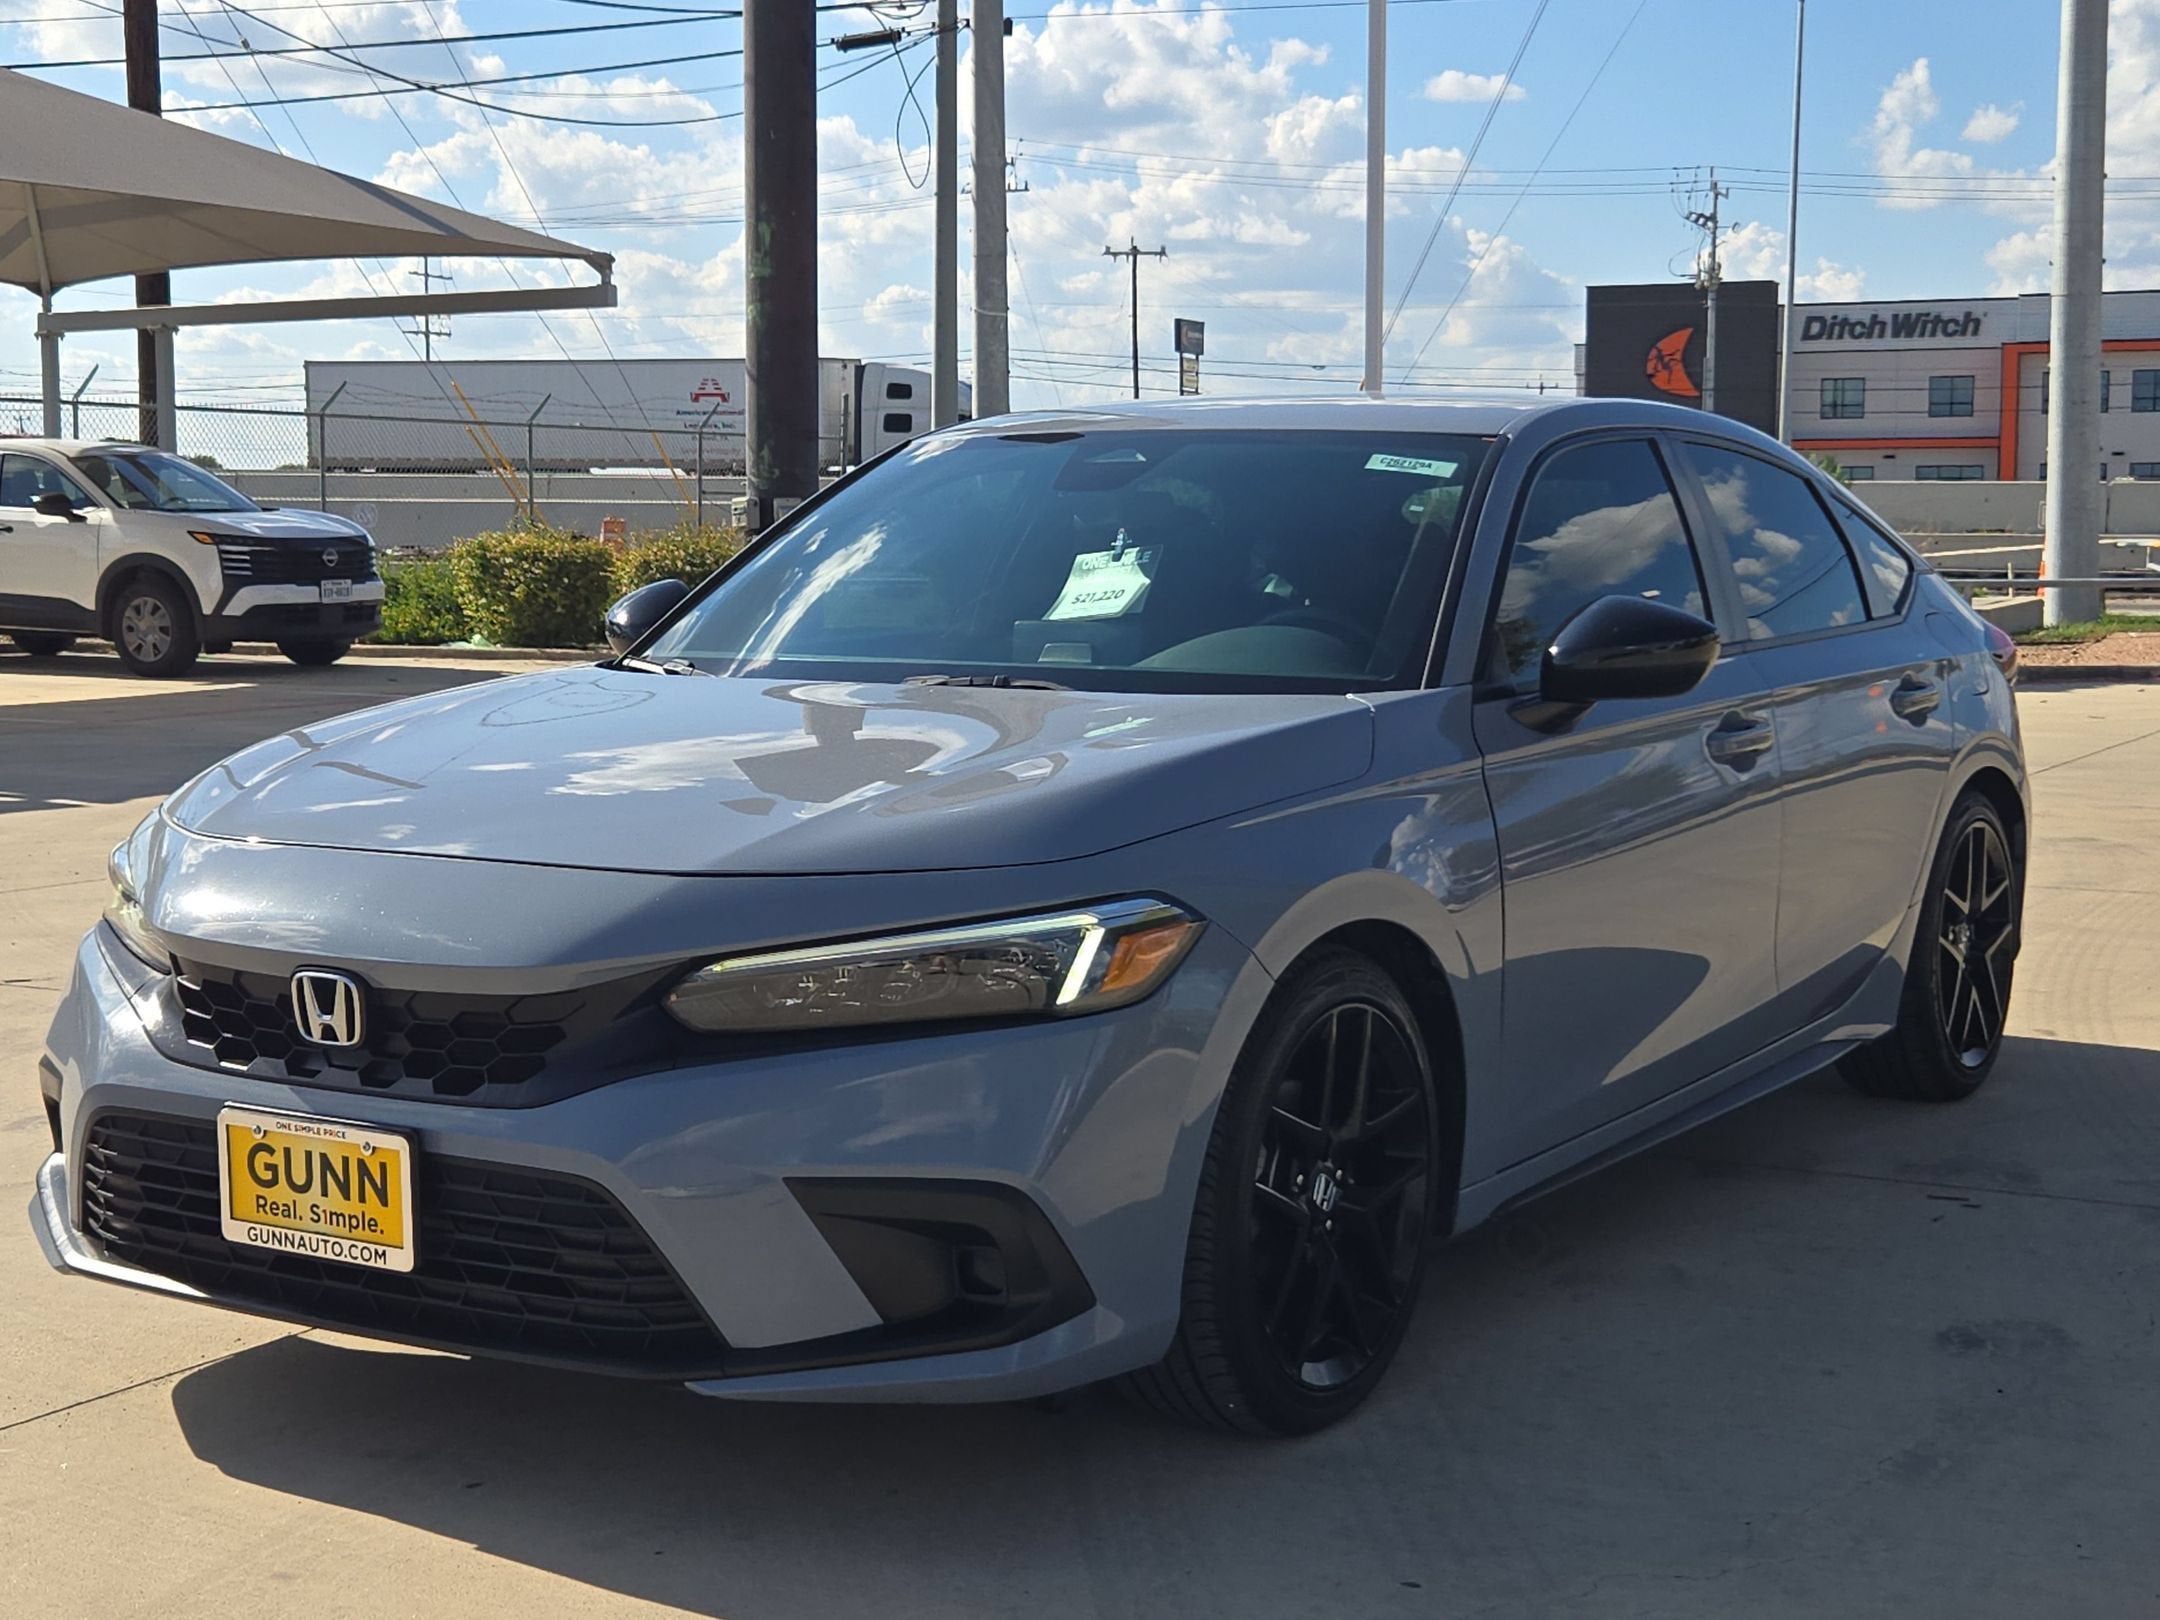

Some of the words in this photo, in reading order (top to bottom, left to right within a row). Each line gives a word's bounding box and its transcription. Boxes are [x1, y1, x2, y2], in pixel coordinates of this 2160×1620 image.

[1800, 313, 1887, 341] Ditch
[1890, 311, 1981, 339] Witch
[1082, 555, 1109, 570] ONE
[1071, 589, 1125, 605] $21,220
[276, 1121, 292, 1131] ONE
[247, 1142, 389, 1208] GUNN
[256, 1194, 303, 1221] Real.
[247, 1226, 387, 1265] GUNNAUTO.COM
